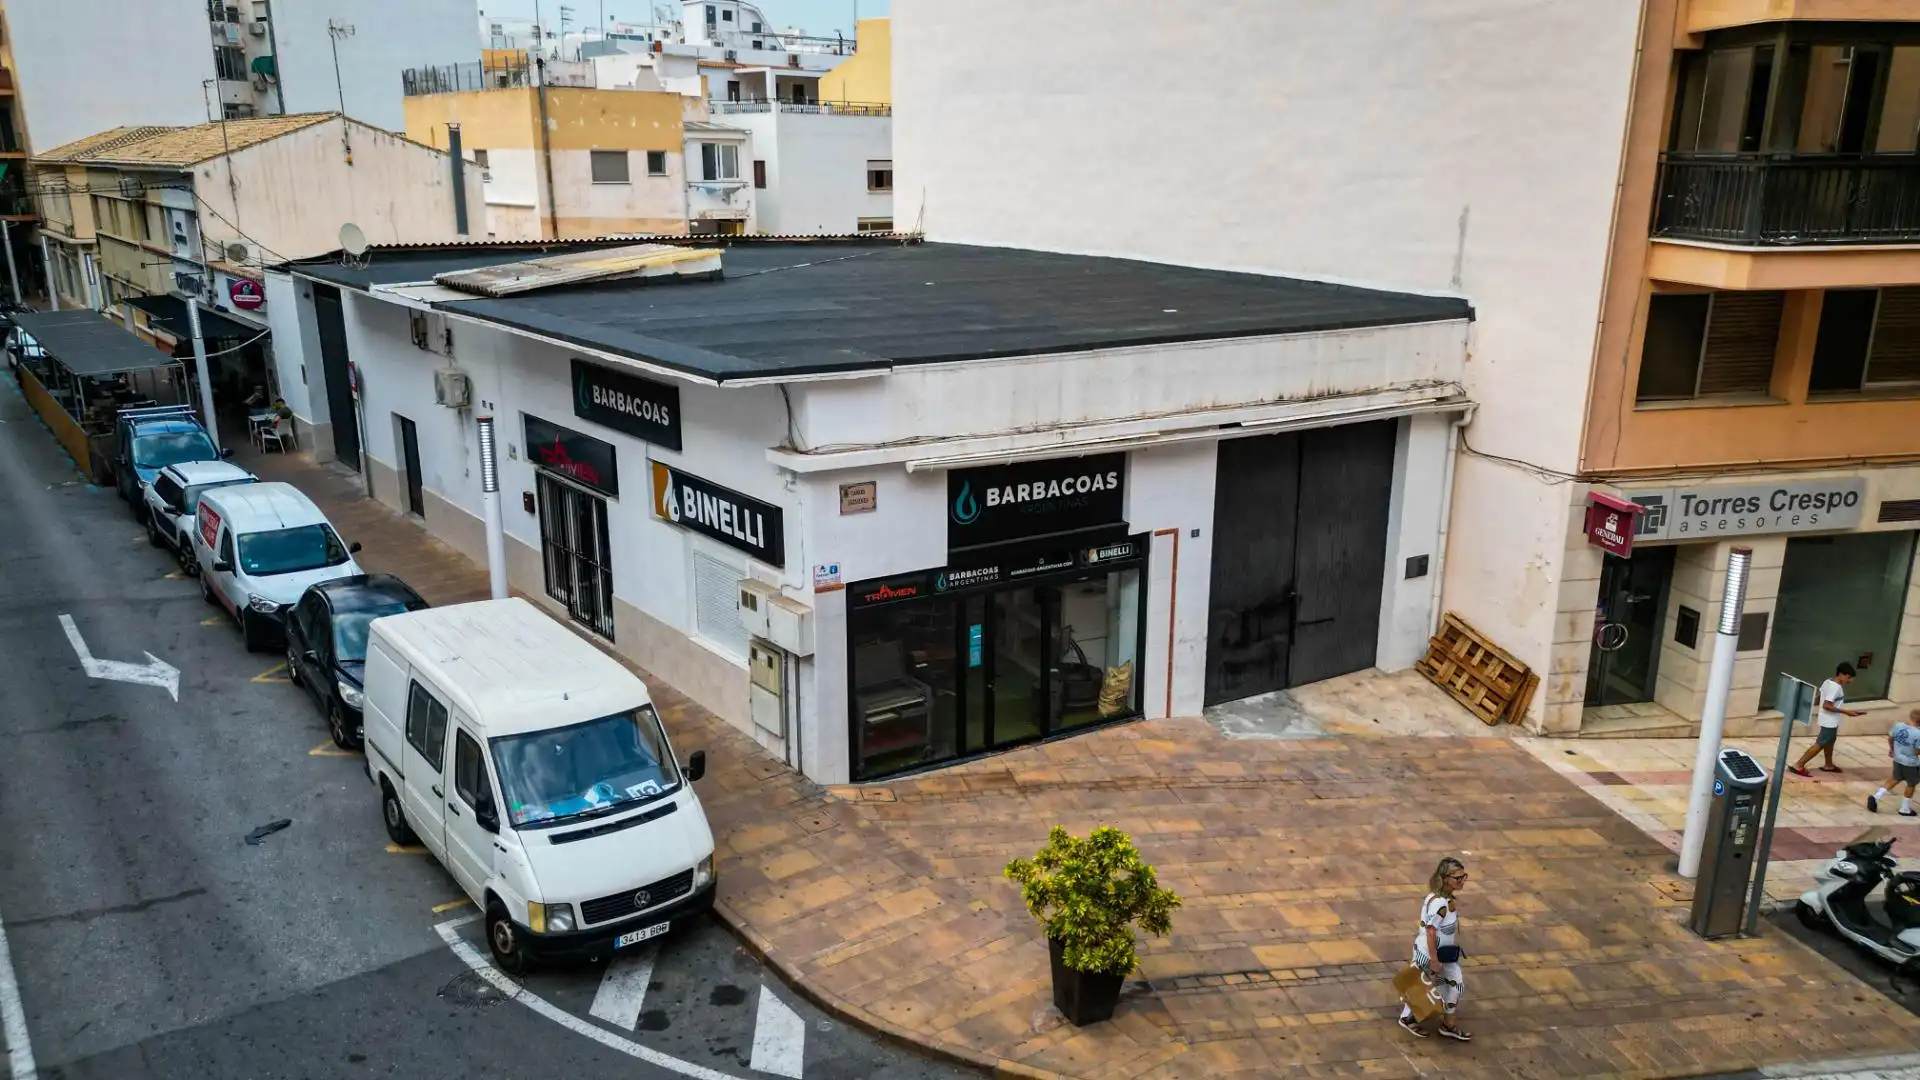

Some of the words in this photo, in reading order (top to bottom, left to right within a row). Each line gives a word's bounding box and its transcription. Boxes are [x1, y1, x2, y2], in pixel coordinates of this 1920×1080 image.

[592, 384, 670, 427] BARBACOAS
[986, 471, 1118, 507] BARBACOAS
[1680, 493, 1761, 517] Torres
[1769, 488, 1859, 514] Crespo
[682, 484, 765, 549] BINELLI
[1679, 513, 1819, 532] asesores
[1595, 527, 1624, 545] GENERALI
[1099, 546, 1129, 558] BINELLI
[949, 566, 999, 581] BARBACOAS
[949, 573, 999, 588] ARGENTINAS
[622, 930, 646, 945] 3413
